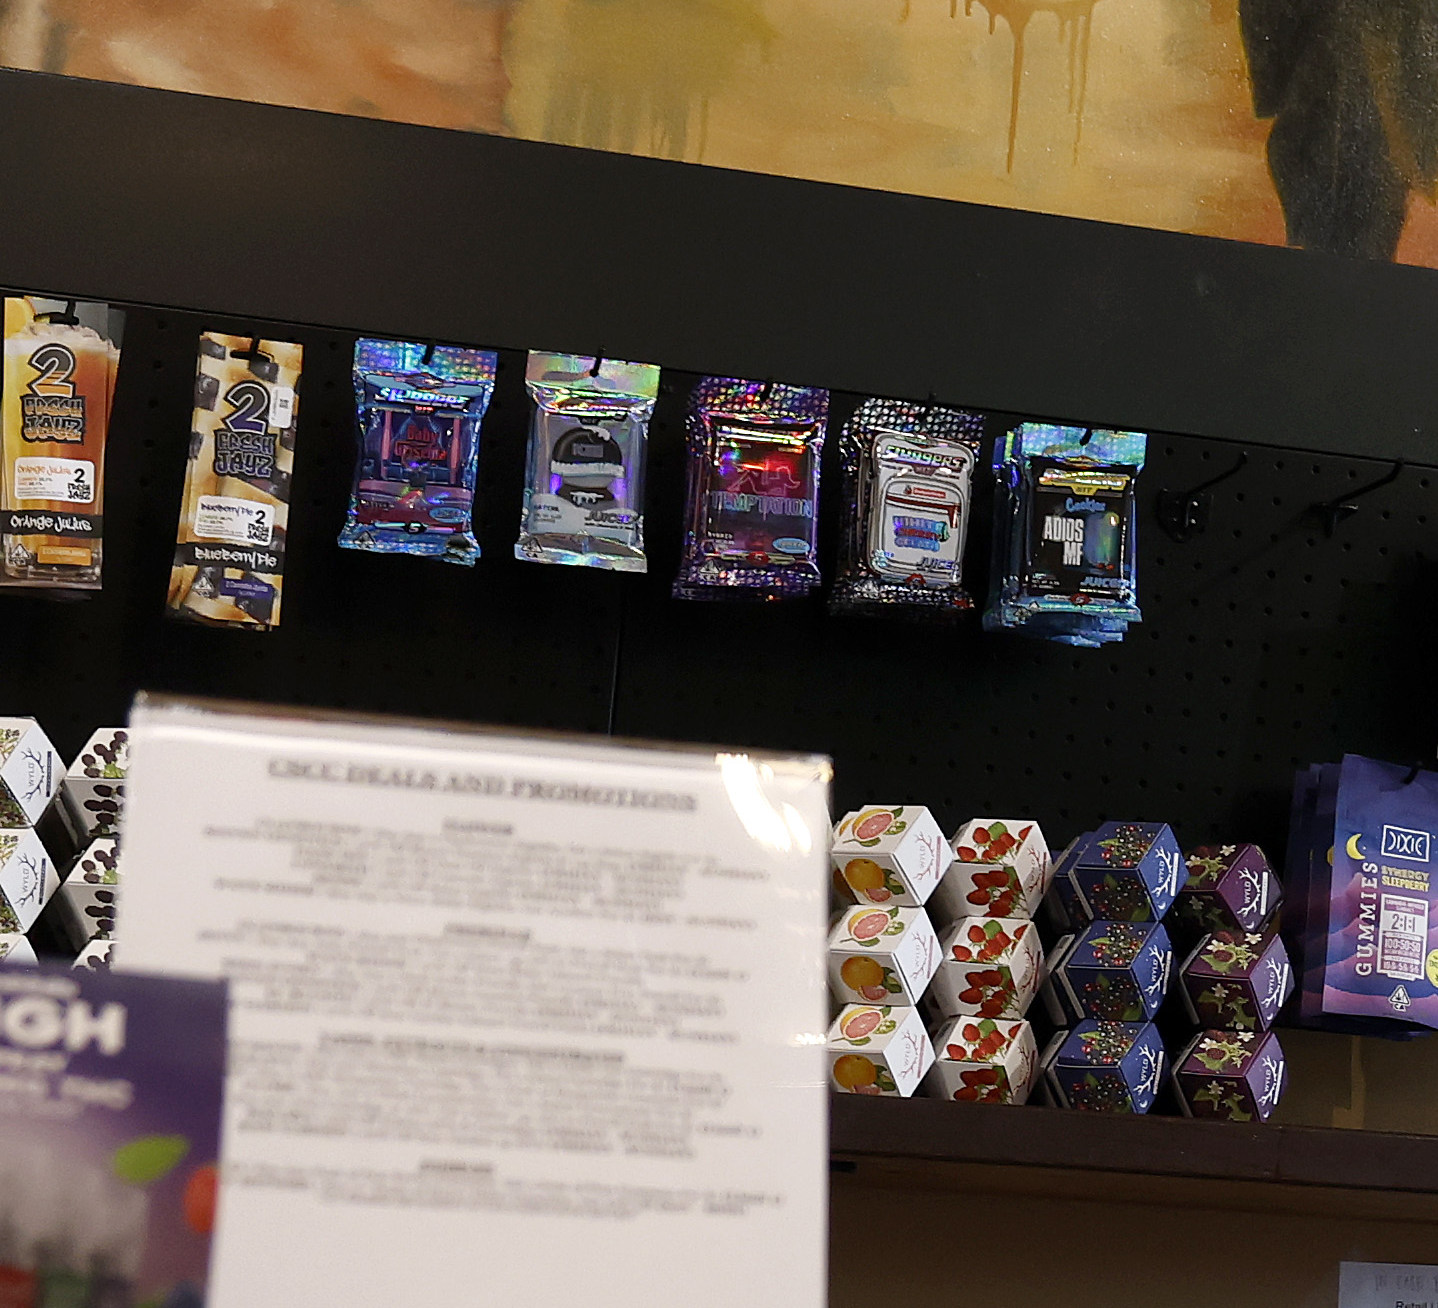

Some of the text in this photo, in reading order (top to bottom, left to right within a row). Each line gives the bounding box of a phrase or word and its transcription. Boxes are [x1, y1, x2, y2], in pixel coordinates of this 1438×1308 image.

[28, 343, 76, 398] 2
[224, 379, 271, 435] 2
[74, 468, 85, 483] 2
[709, 491, 813, 519] TEMPTATION
[1044, 516, 1084, 542] ADIOS
[1063, 542, 1083, 566] MF
[1389, 831, 1424, 856] DIXIE
[1355, 862, 1378, 976] GUMMIES
[1391, 913, 1416, 933] 2:1:1
